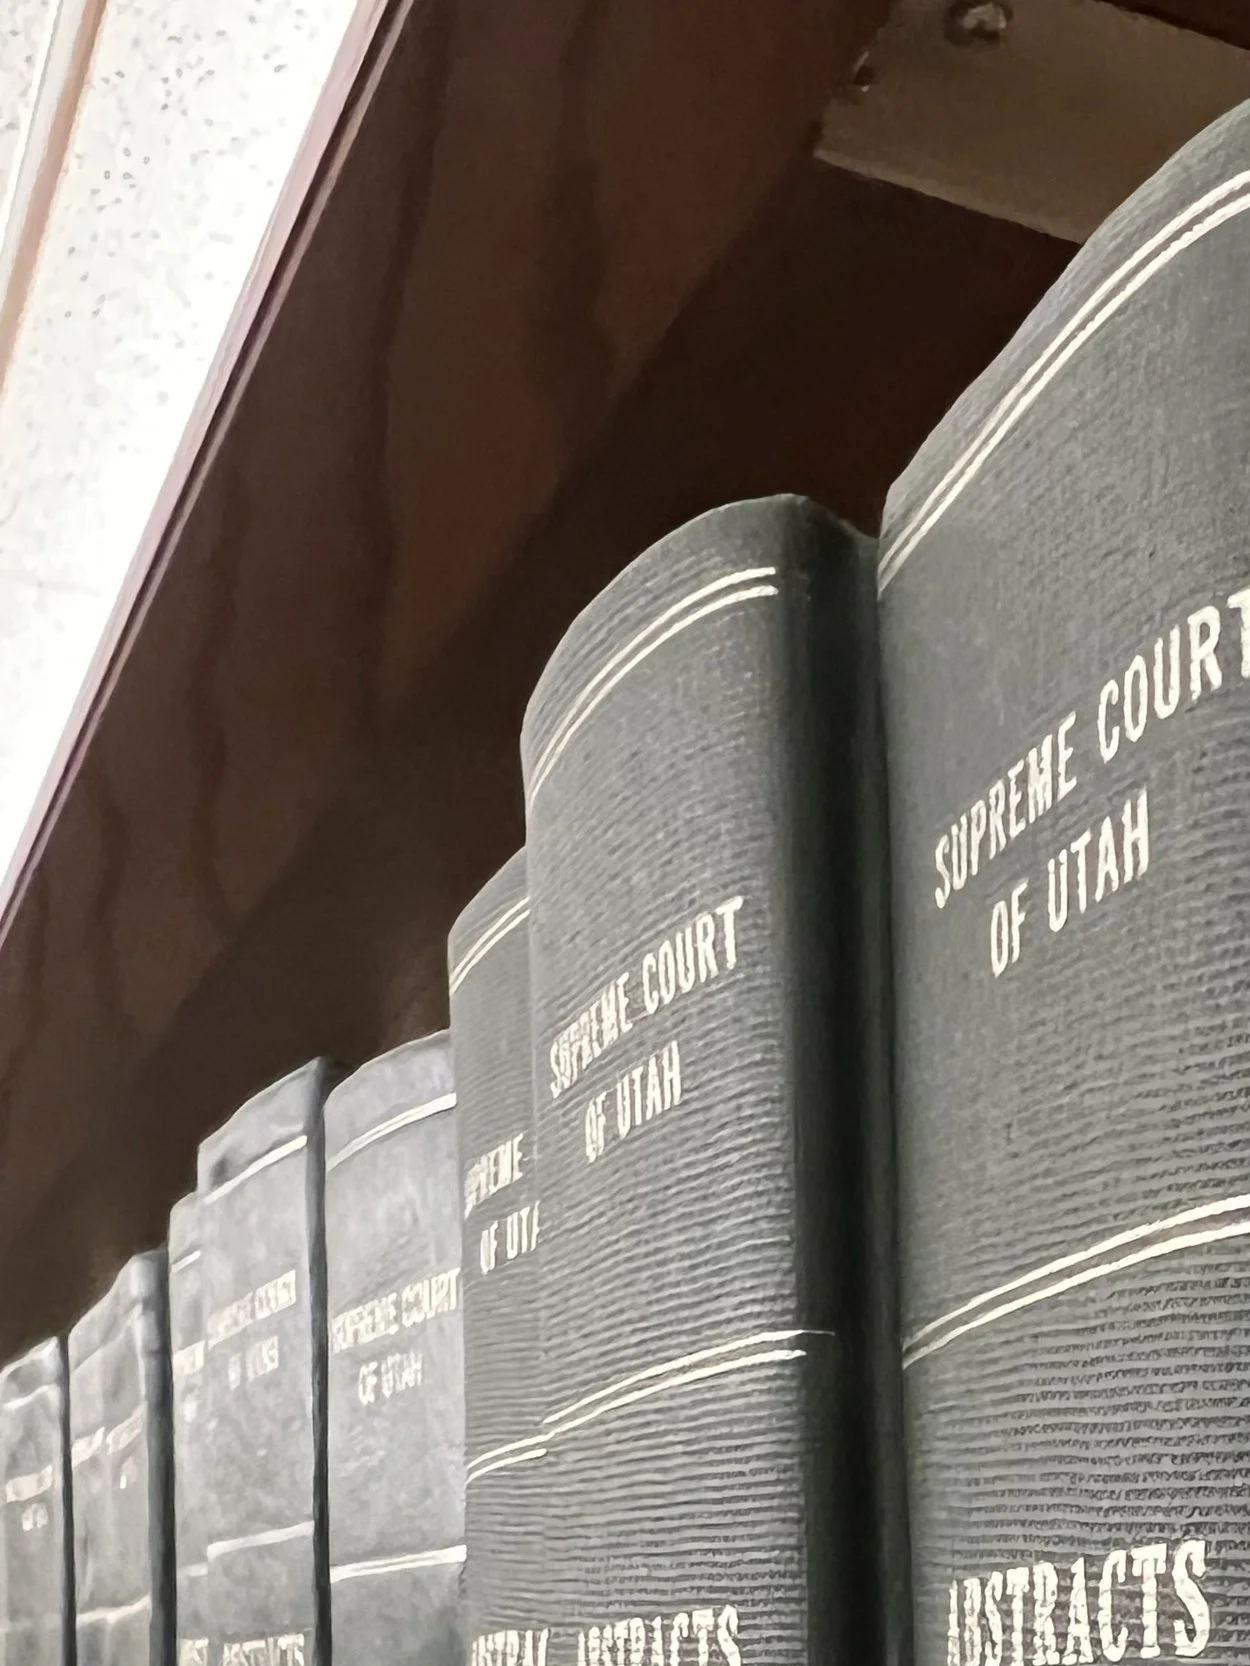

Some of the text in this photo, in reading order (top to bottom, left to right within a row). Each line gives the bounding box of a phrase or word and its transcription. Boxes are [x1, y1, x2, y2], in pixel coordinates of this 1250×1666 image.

[934, 711, 1077, 909] SUPREME
[990, 783, 1149, 979] OF UTAH
[550, 896, 744, 1099] SUPREME COURT
[584, 1040, 682, 1164] OF UTAH
